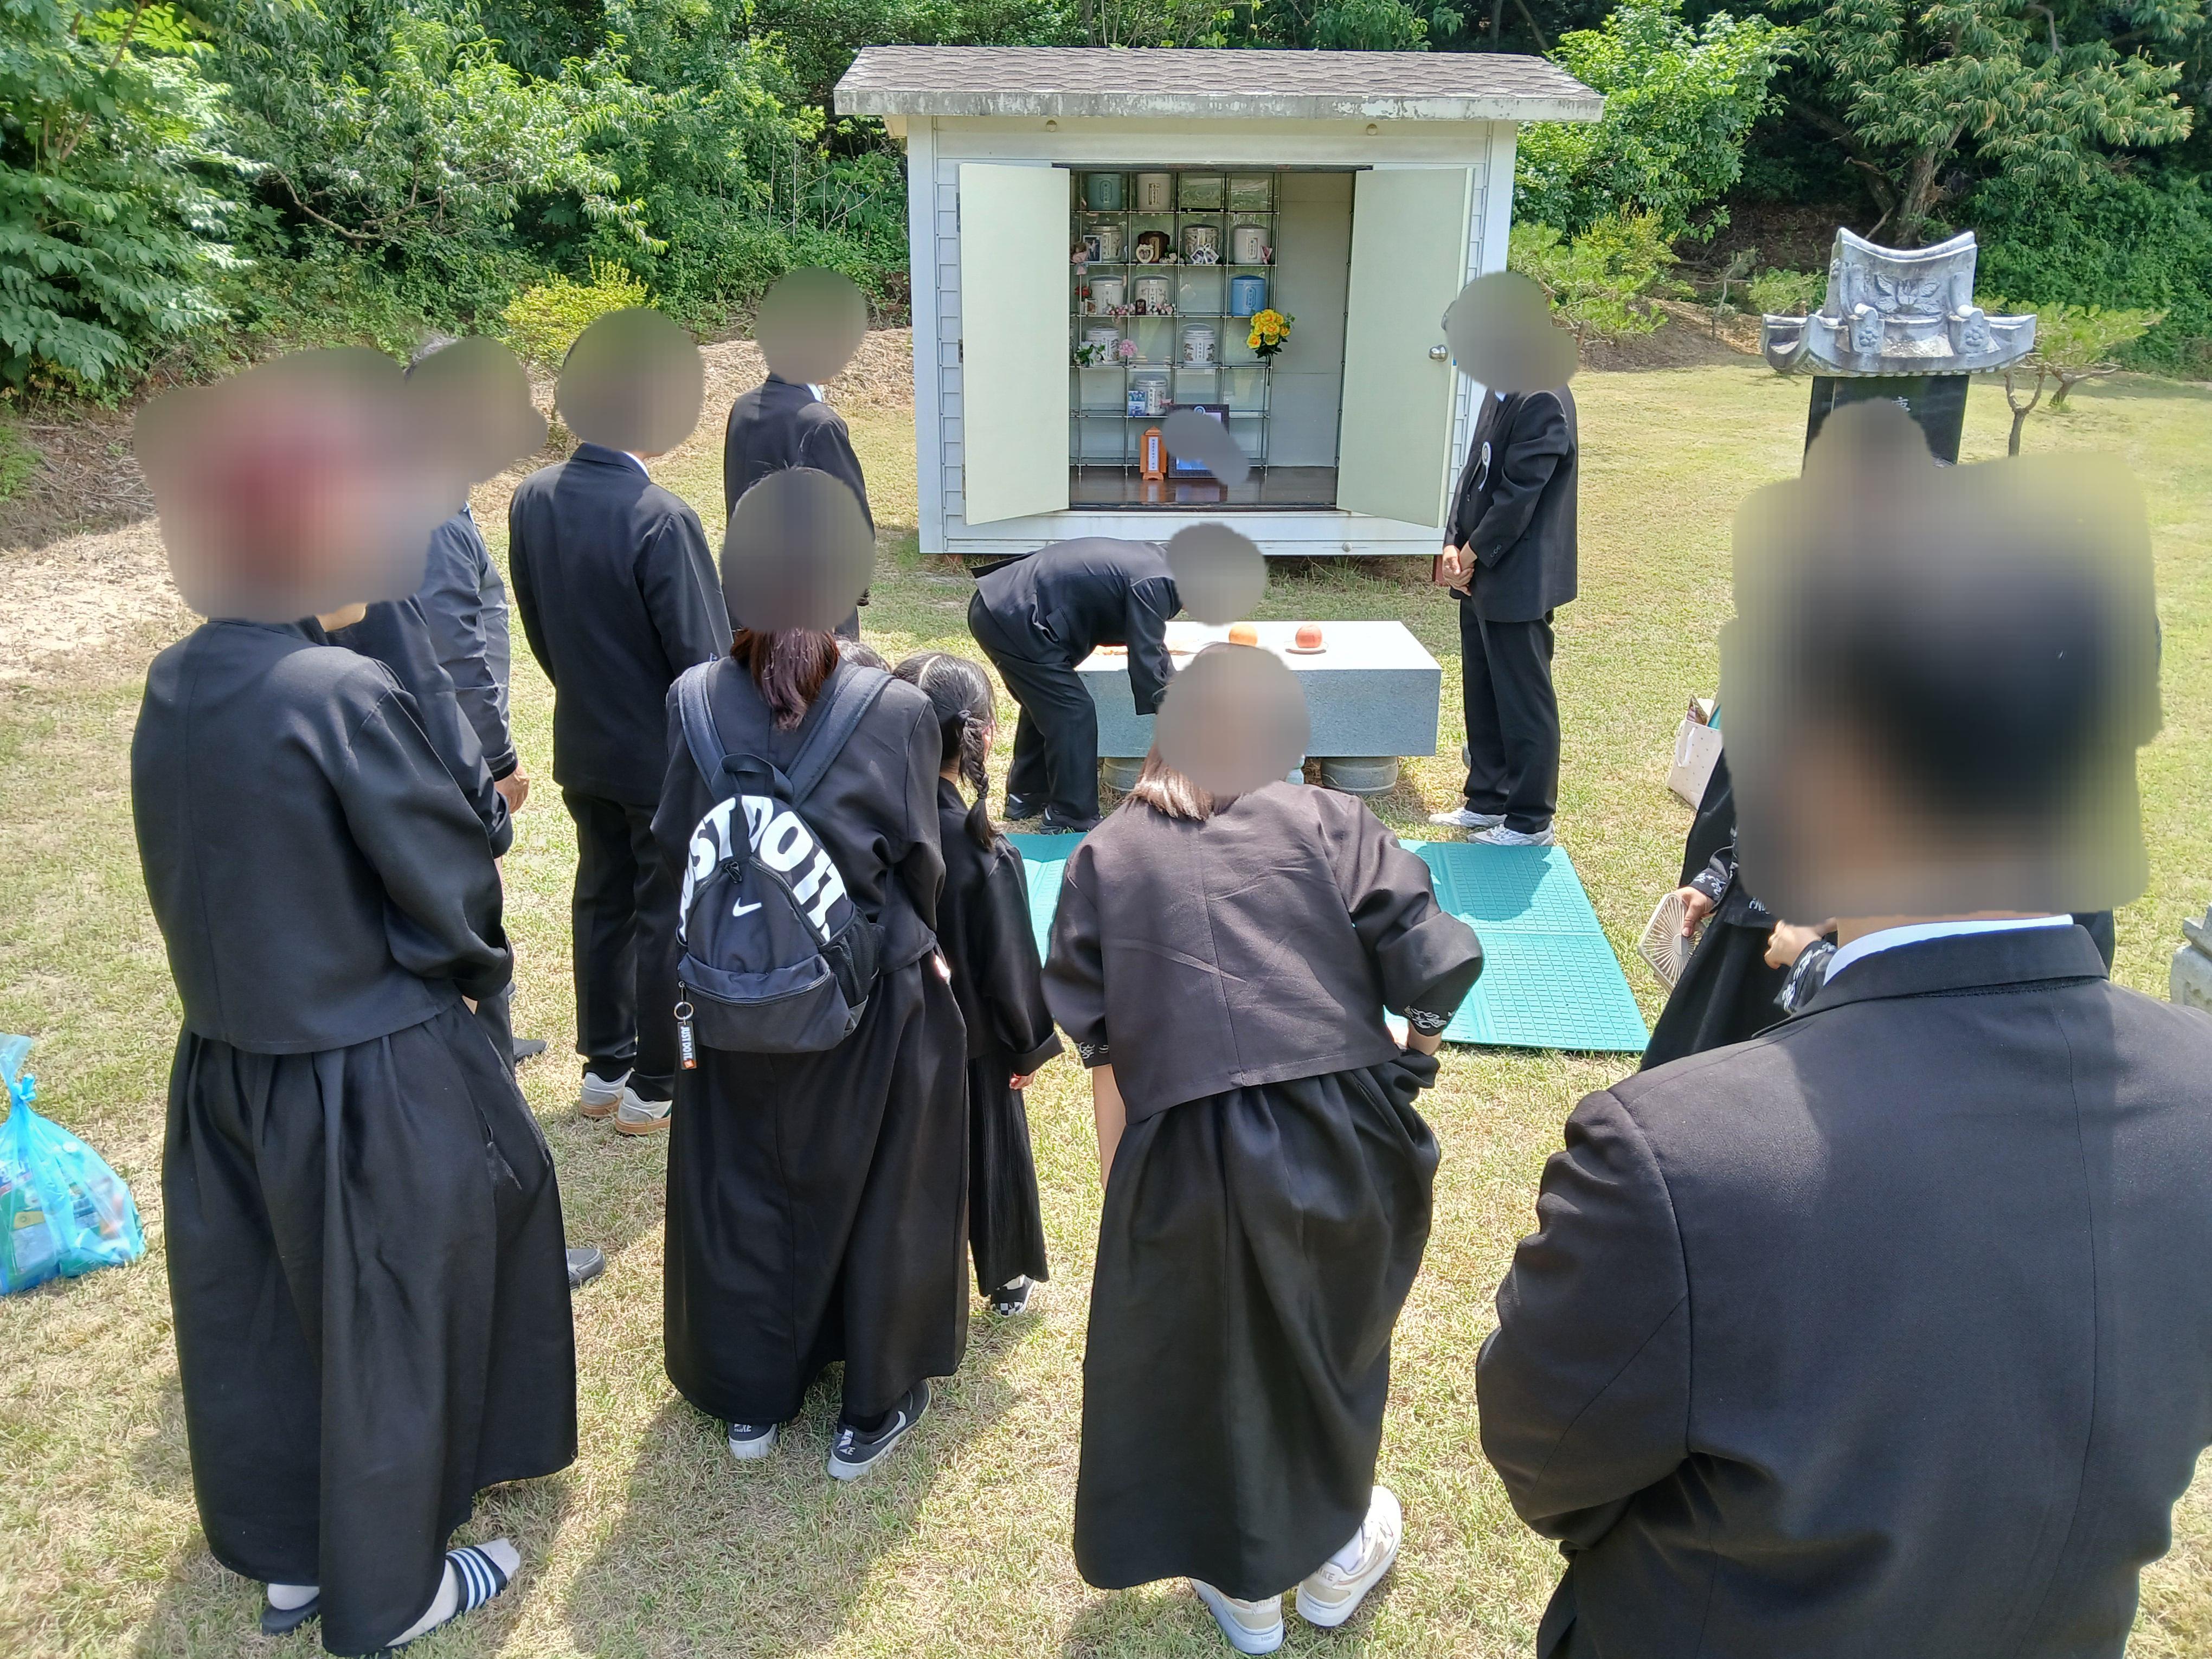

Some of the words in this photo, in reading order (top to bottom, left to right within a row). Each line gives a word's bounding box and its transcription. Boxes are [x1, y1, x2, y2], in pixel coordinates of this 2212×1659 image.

[741, 795, 813, 872] DO
[680, 1026, 691, 1041] JUST
[682, 1042, 692, 1052] DO
